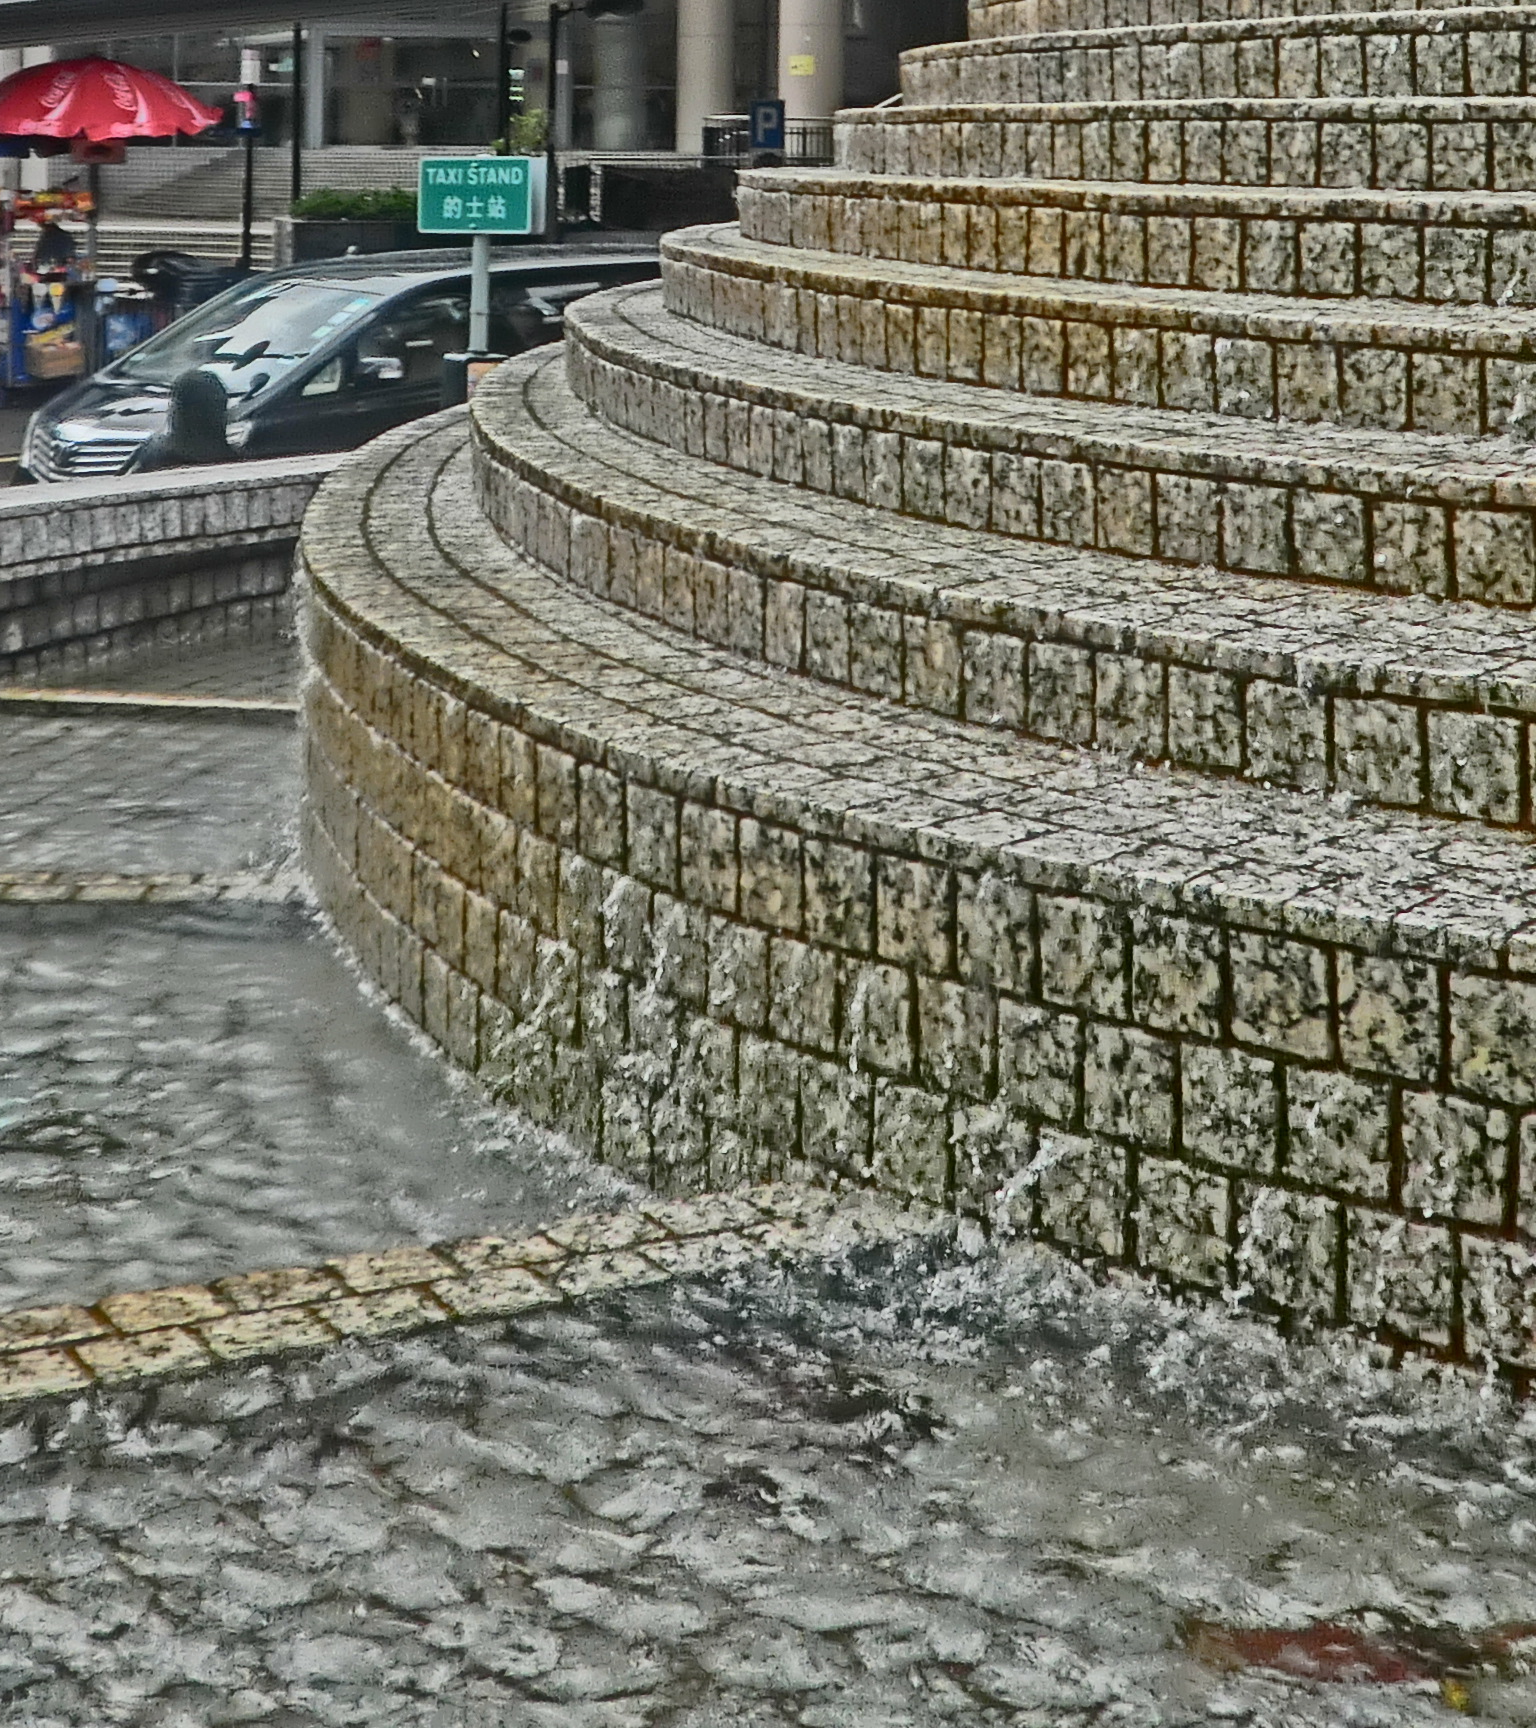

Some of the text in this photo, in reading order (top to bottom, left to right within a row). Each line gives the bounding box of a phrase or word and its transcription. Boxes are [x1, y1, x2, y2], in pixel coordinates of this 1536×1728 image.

[757, 107, 778, 143] P
[426, 166, 524, 185] TAXI STAND
[443, 195, 506, 219] 的士站
